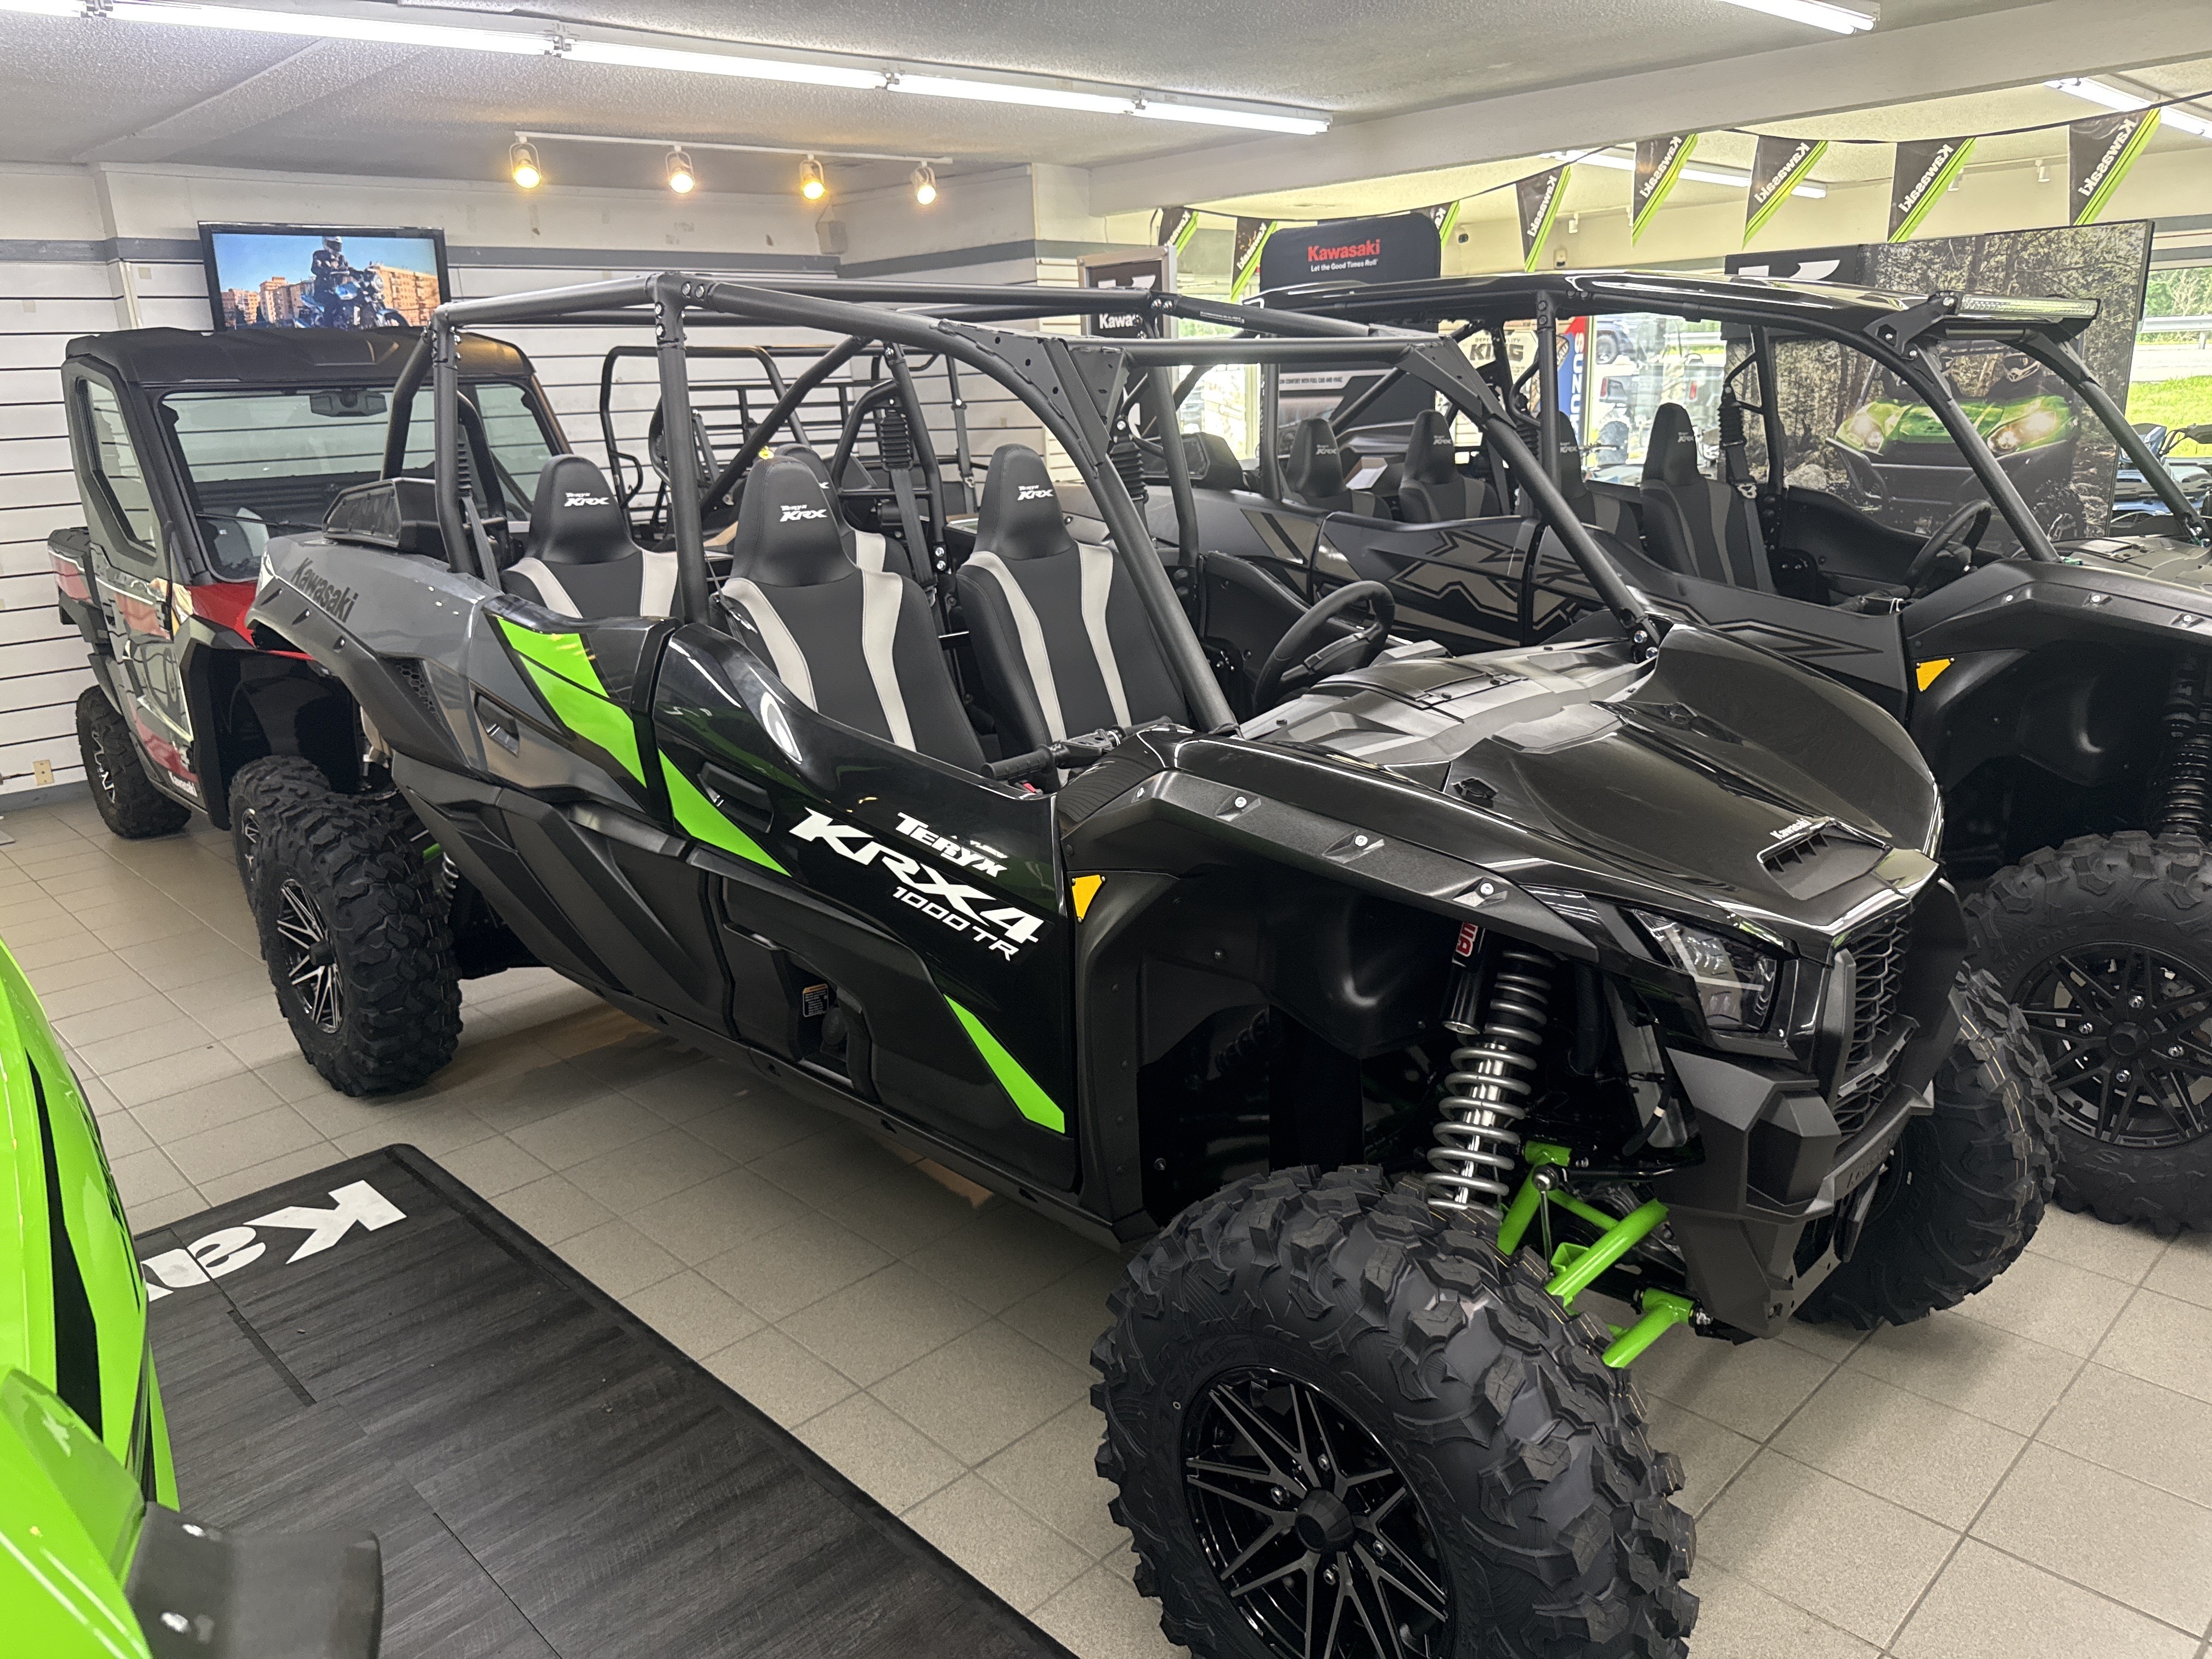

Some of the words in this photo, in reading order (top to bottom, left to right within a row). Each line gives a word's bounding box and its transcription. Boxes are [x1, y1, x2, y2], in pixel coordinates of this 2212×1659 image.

[1308, 239, 1381, 262] Kawasaki
[1331, 262, 1346, 270] Good
[1470, 343, 1523, 362] KIG
[564, 497, 610, 507] KRX
[1017, 489, 1054, 500] KRX
[780, 509, 827, 522] KRX
[290, 557, 358, 623] Kawasaki
[1770, 817, 1812, 839] Kawasaki
[789, 806, 1045, 944] KRX4
